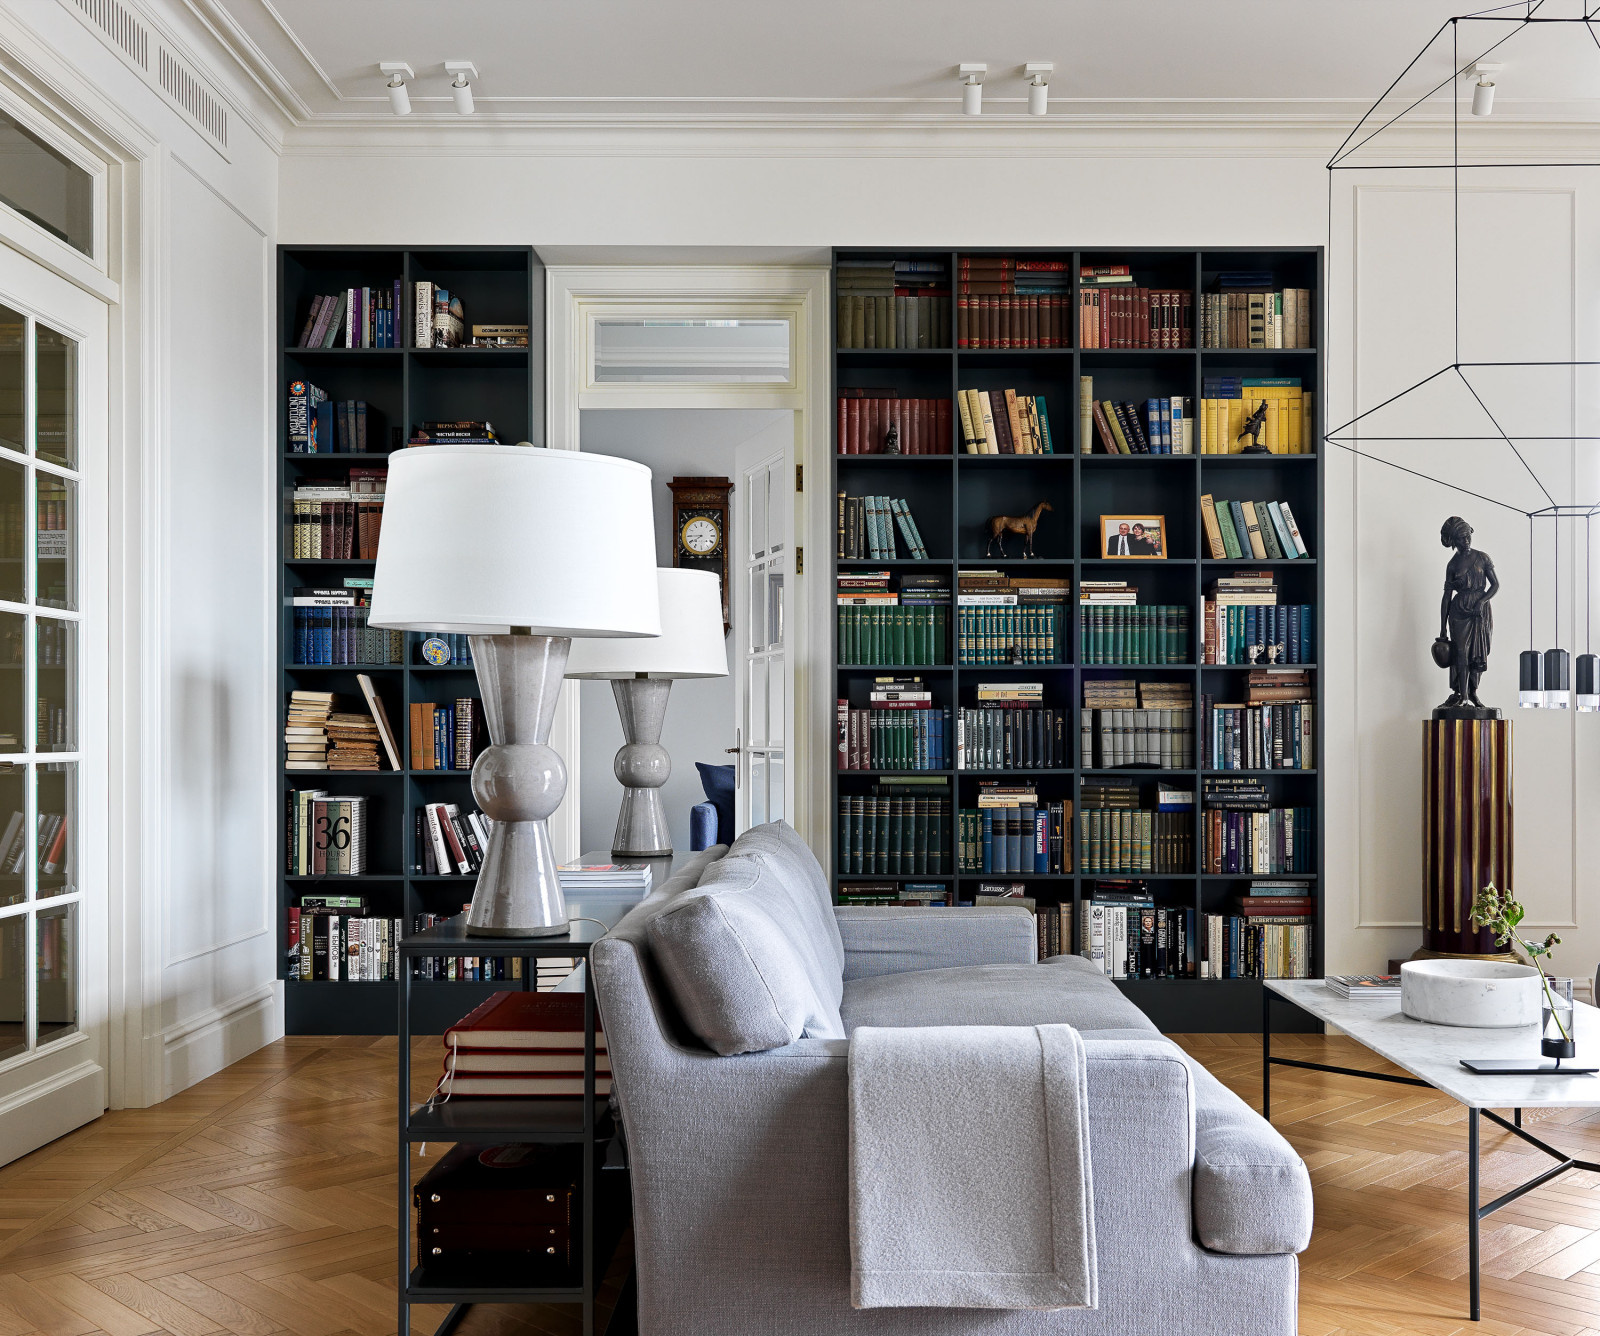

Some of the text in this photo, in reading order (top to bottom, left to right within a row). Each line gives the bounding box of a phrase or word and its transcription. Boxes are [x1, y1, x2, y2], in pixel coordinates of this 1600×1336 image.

[418, 288, 426, 338] Lewis Carroll
[298, 396, 307, 435] THE MACMILLAN
[315, 816, 351, 850] 36
[428, 808, 438, 835] Sapiens
[319, 850, 346, 858] HOURS
[980, 883, 1005, 893] Larousse
[1157, 909, 1166, 922] JOHN
[331, 935, 339, 961] БЫКОВ
[1091, 951, 1104, 959] США
[303, 955, 311, 975] ПЯТЬ
